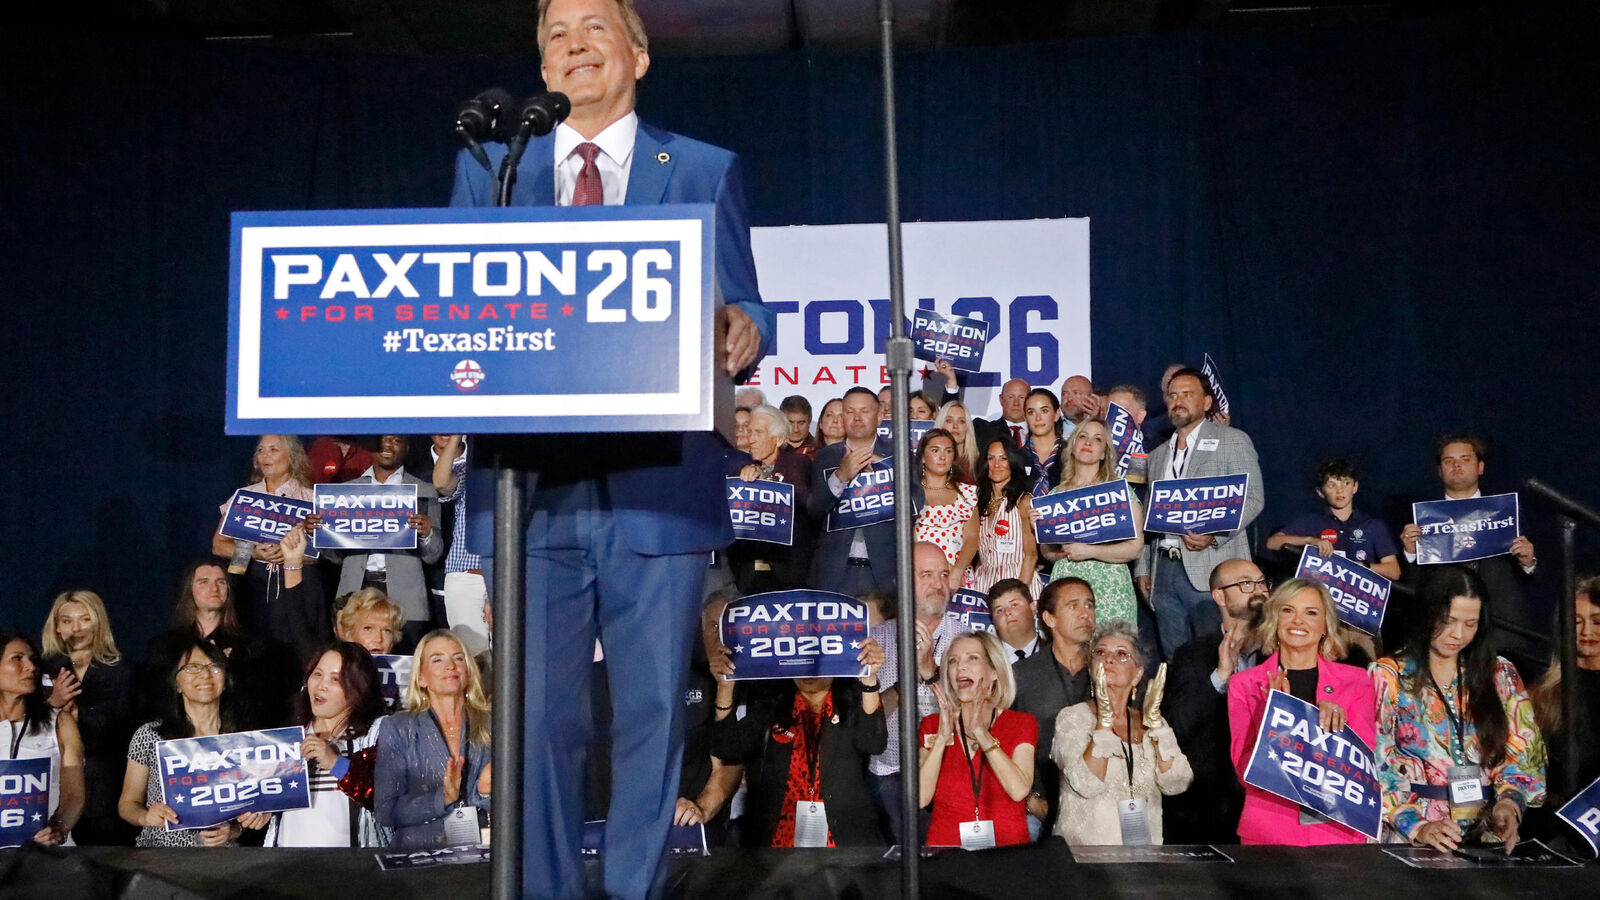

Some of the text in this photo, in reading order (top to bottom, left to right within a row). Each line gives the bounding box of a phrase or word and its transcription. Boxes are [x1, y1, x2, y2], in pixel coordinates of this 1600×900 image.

[271, 248, 673, 323] PAXTON 26
[300, 303, 548, 322] FOR SENATE
[382, 327, 556, 353] #TexasFirst
[915, 317, 986, 342] PAXTON
[951, 295, 1059, 387] 26
[923, 338, 972, 358] 2026
[318, 495, 414, 509] PAXTON
[838, 491, 895, 514] 2026
[1037, 489, 1128, 520] PAXTON
[1155, 484, 1245, 502] PAXTON
[1188, 498, 1242, 509] SENATE
[1073, 503, 1128, 519] SENATE
[1166, 507, 1227, 524] 2026
[334, 518, 400, 533] 2026
[1055, 512, 1117, 536] 2026
[1421, 516, 1515, 535] #TexasFirst
[1305, 555, 1387, 601] PAXTON
[1323, 582, 1370, 616] 026
[728, 602, 864, 623] PAXTON
[727, 622, 865, 635] FOR SENATE
[751, 635, 844, 658] 2026
[1271, 706, 1379, 781] PAXTON
[164, 743, 301, 775] PAXTON
[1267, 730, 1382, 793] FOR SENATE
[169, 774, 208, 787] FOR
[1280, 751, 1365, 806] 2026
[191, 778, 283, 807] 2026
